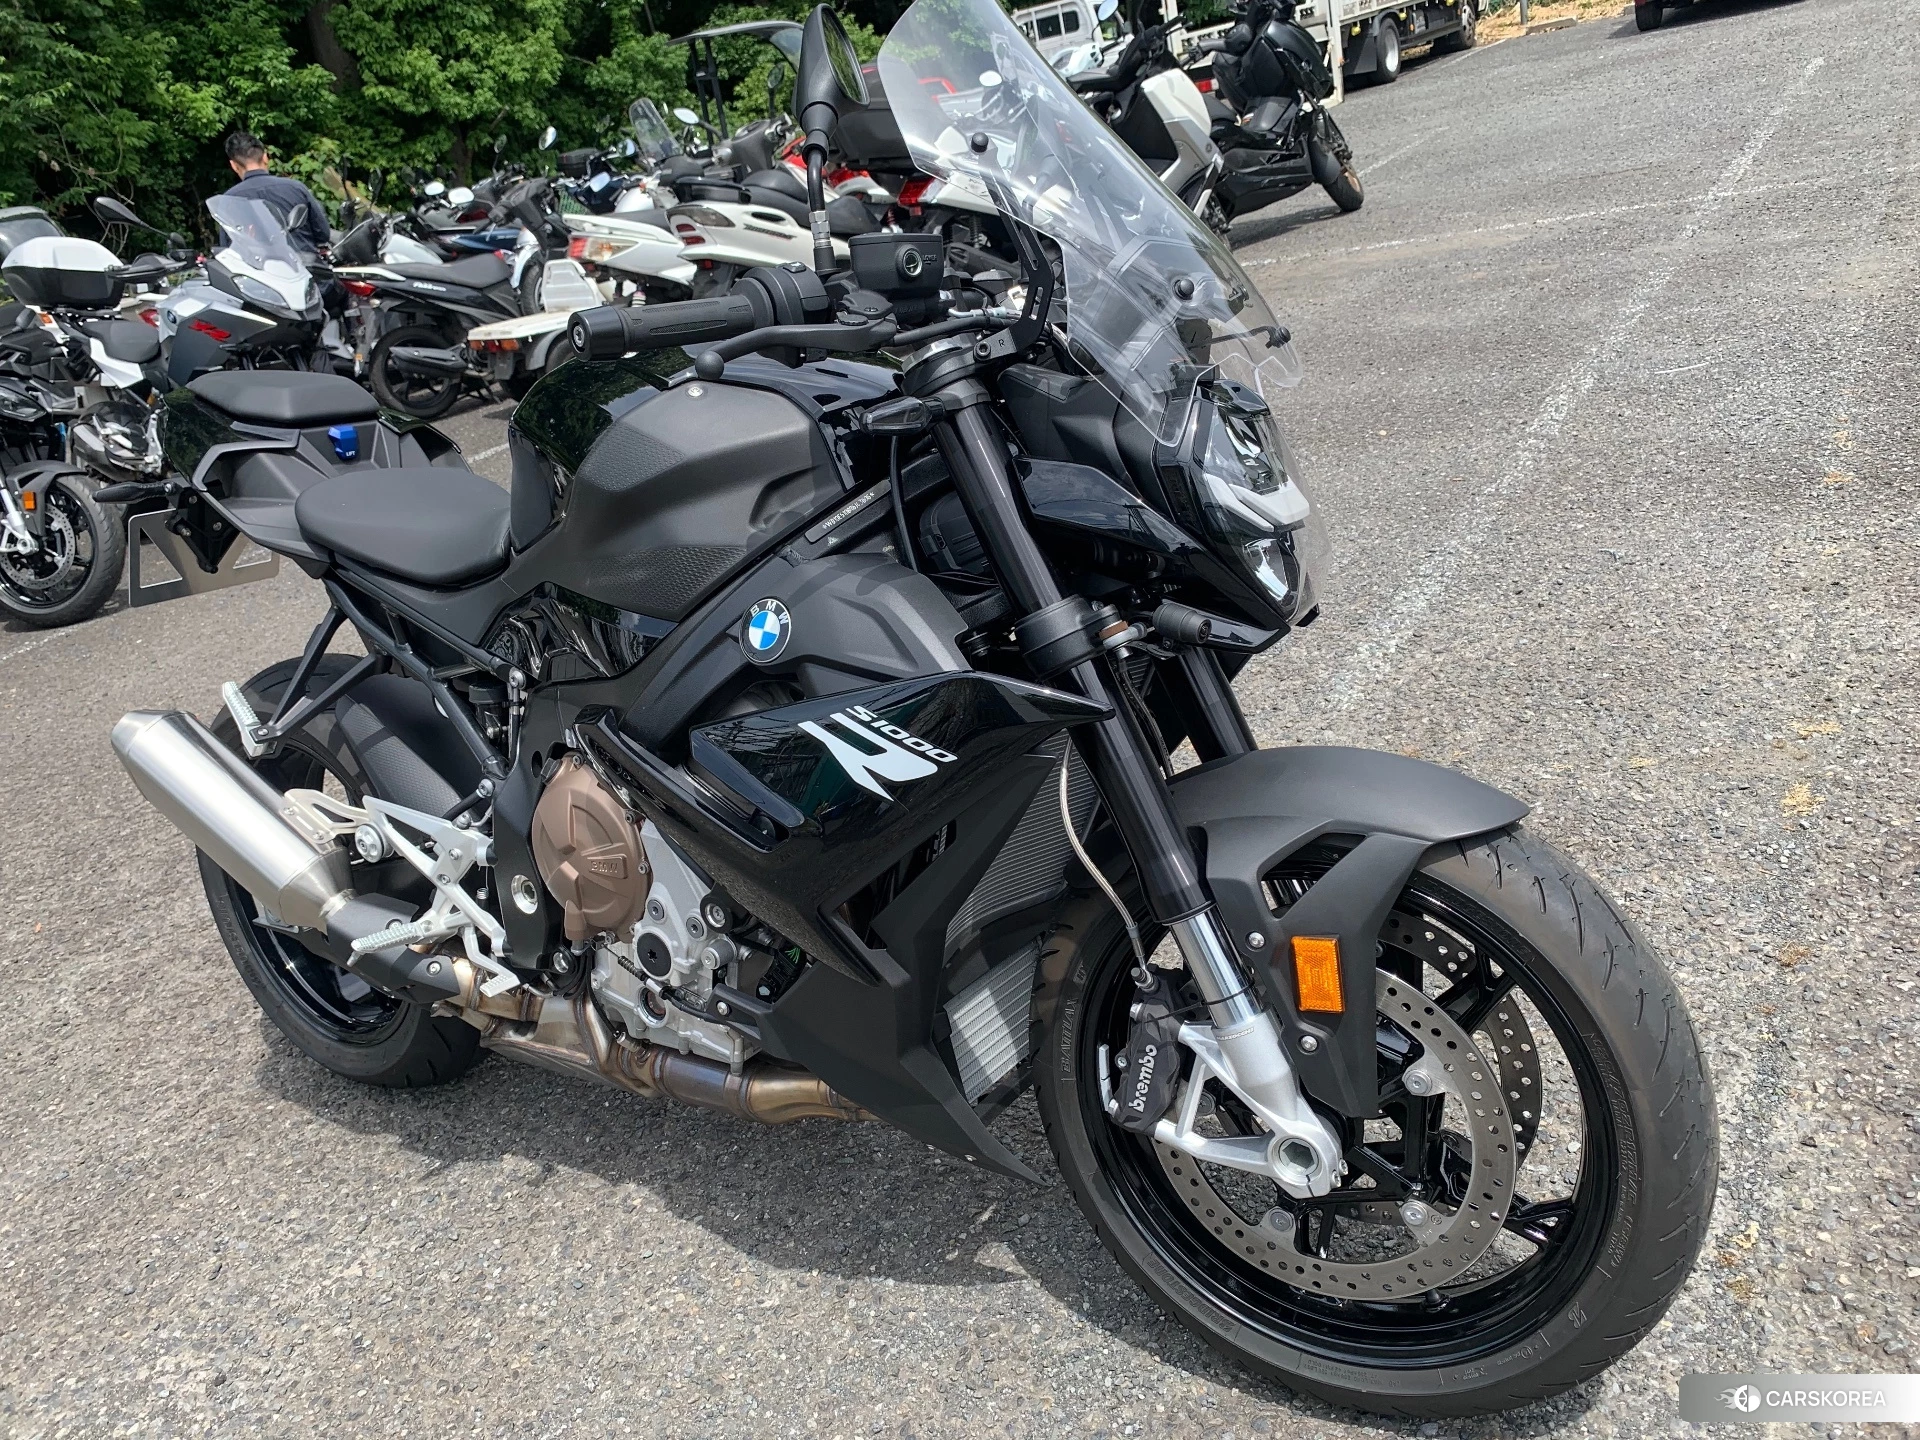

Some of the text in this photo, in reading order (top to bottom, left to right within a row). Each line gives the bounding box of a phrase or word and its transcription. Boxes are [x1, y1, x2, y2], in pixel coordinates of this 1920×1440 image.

[998, 338, 1005, 347] R
[750, 600, 790, 625] BMW
[797, 705, 958, 801] S1000 R
[590, 860, 620, 873] BMW
[1128, 1044, 1157, 1113] brembo
